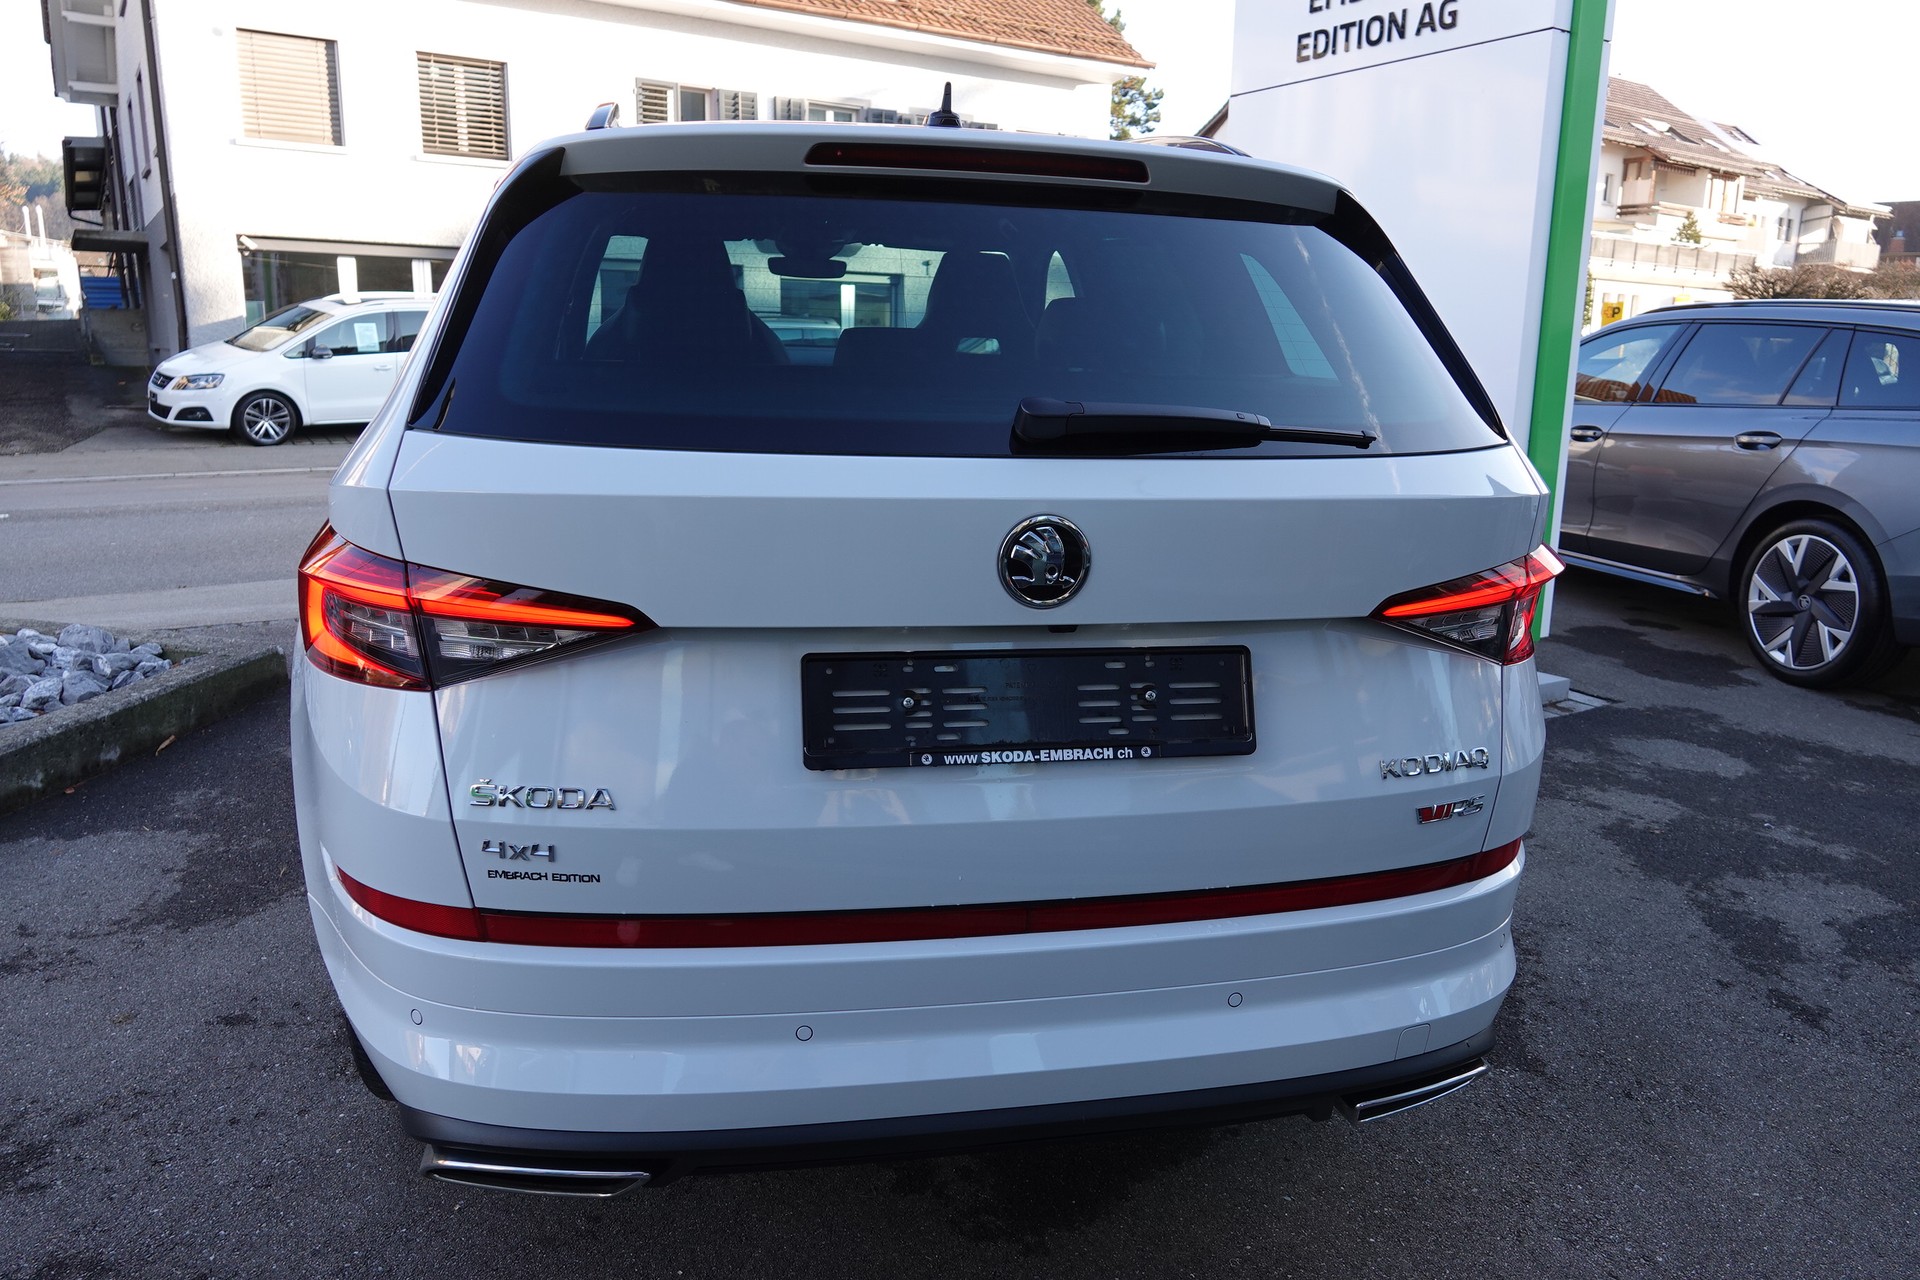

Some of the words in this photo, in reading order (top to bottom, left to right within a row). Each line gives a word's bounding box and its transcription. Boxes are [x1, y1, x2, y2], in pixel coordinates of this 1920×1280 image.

[1296, 8, 1407, 63] EDITION
[1415, 0, 1458, 36] AG
[1612, 307, 1620, 317] P
[944, 754, 978, 764] www
[981, 748, 1113, 763] SKODA-EMBRACH
[1117, 747, 1133, 758] ch
[1380, 747, 1488, 779] KODIAQ
[470, 779, 616, 811] ŠKODA
[482, 840, 555, 863] 4x4
[488, 870, 548, 881] EMBRACH
[552, 873, 600, 883] EDITION
